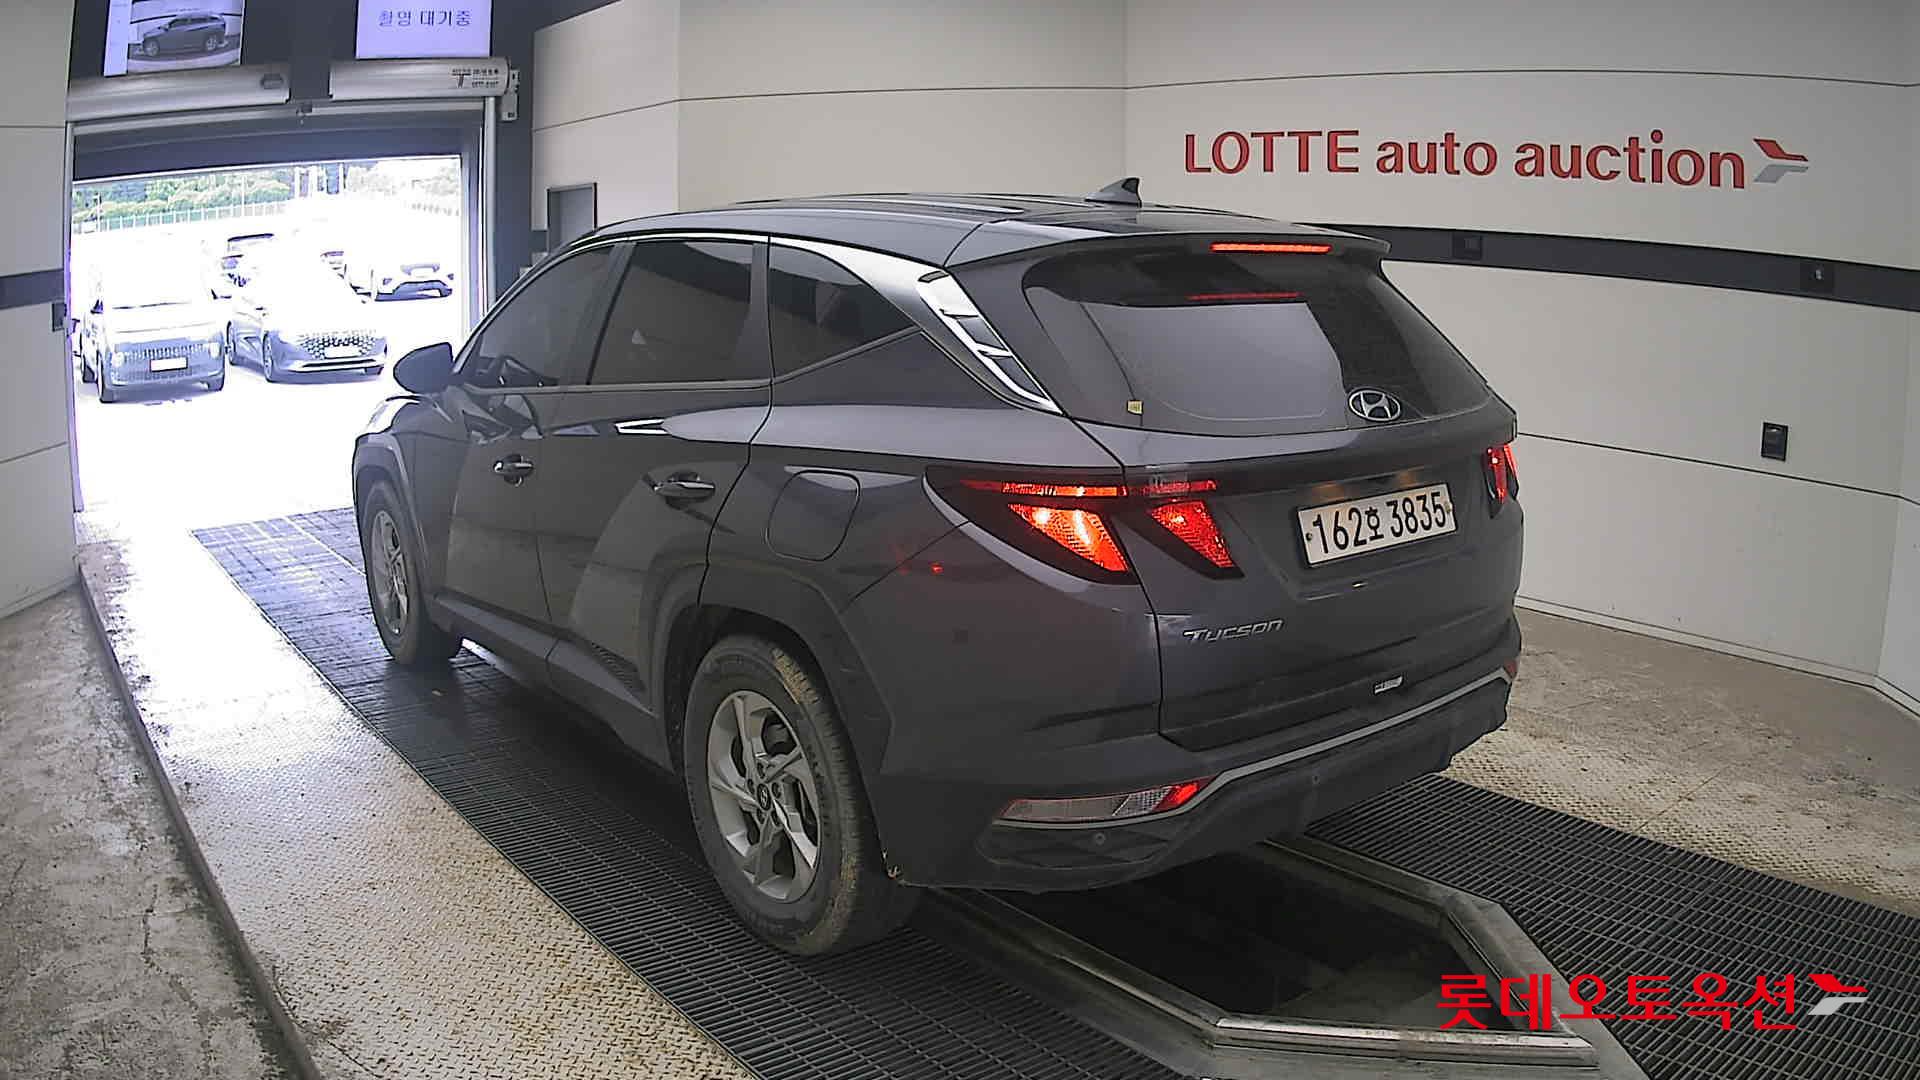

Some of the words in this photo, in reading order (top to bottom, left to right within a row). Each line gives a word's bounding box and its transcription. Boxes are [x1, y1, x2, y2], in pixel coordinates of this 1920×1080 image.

[420, 10, 472, 27] 대기중
[1185, 130, 1360, 174] LOTTE
[1376, 132, 1499, 176] auto
[1514, 130, 1746, 190] auction
[1312, 507, 1385, 554] 162호
[1386, 491, 1446, 538] 3835
